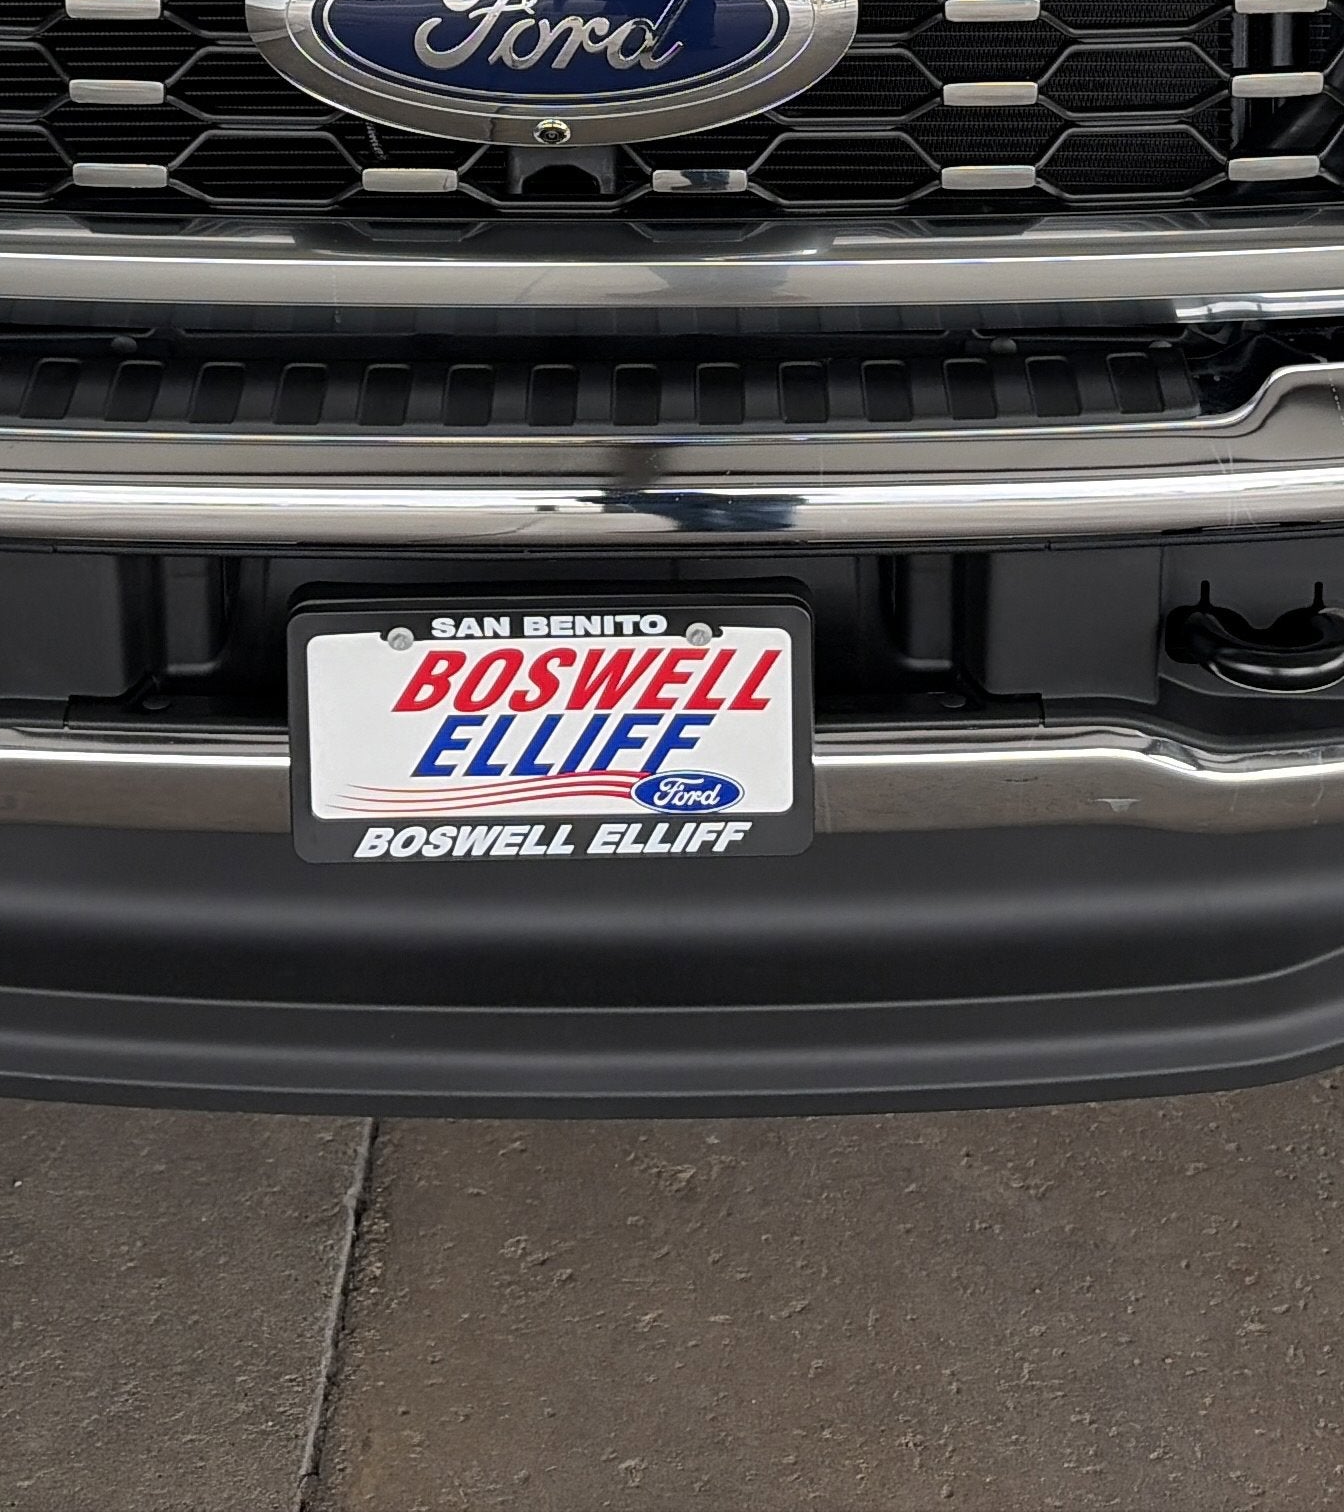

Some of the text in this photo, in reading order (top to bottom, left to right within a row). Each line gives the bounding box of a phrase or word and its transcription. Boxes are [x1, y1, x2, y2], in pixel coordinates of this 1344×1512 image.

[431, 614, 668, 639] SAN BENITO
[392, 647, 783, 713] BOSWELL
[410, 713, 717, 778] ELLIFF
[653, 777, 721, 809] Ford
[353, 821, 753, 859] BOSWELL ELLIFF
